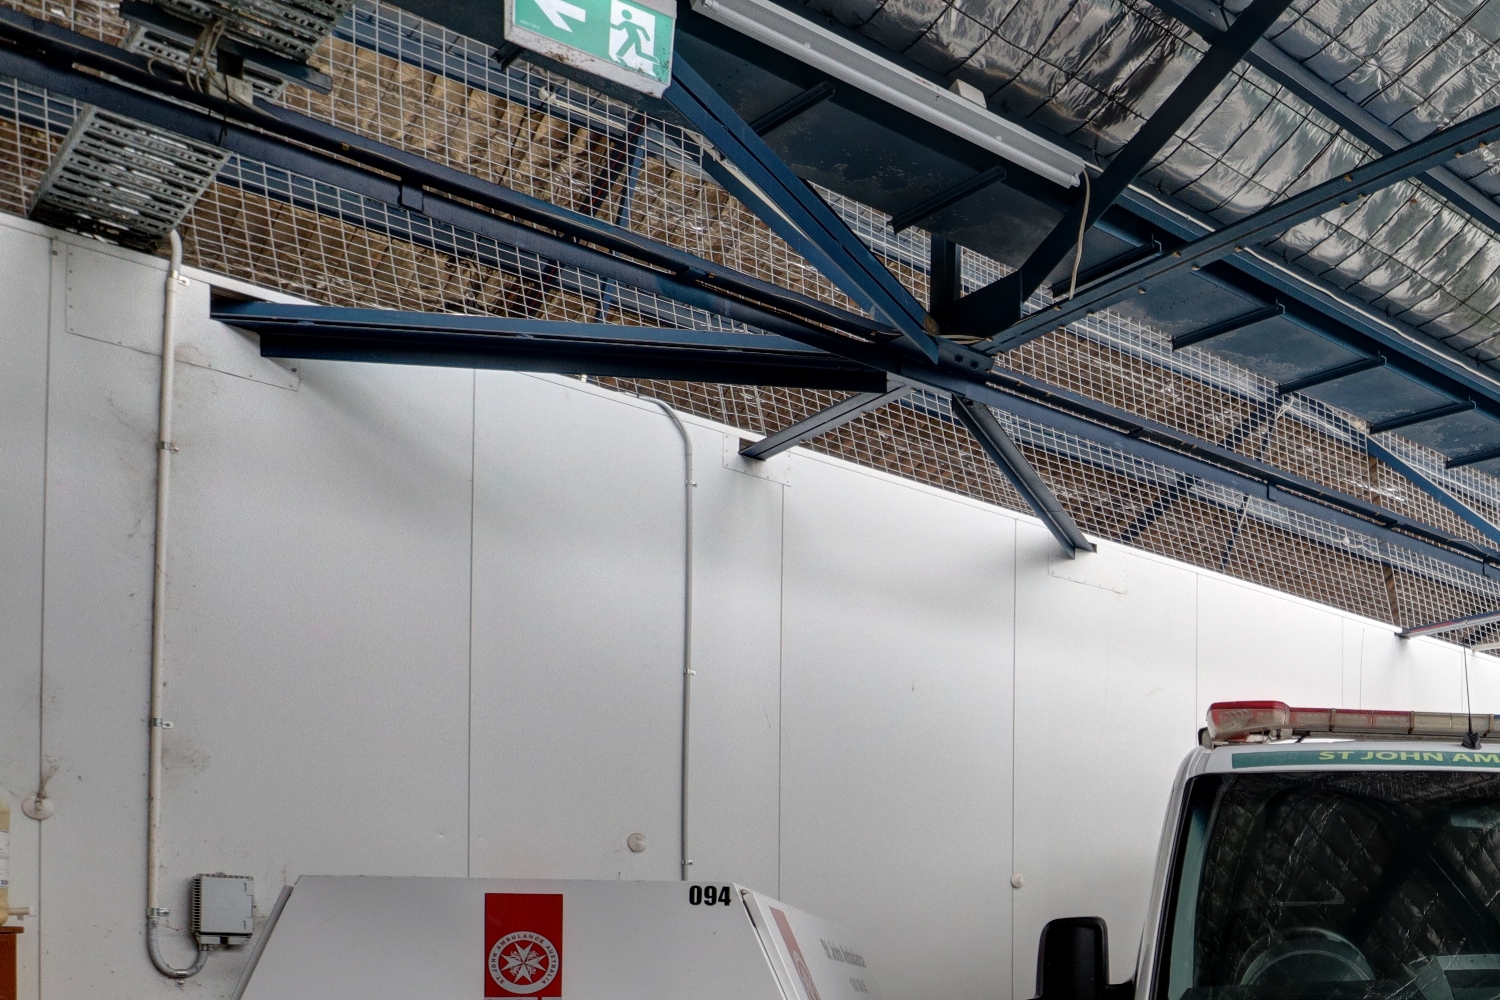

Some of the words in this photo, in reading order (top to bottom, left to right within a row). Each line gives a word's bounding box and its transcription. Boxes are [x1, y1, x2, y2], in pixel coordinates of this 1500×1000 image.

[1318, 750, 1354, 761] ST
[1361, 751, 1444, 762] JOHN
[689, 885, 732, 906] 094
[496, 933, 544, 950] AMBULANCE
[541, 945, 557, 984] AUSTRALIA
